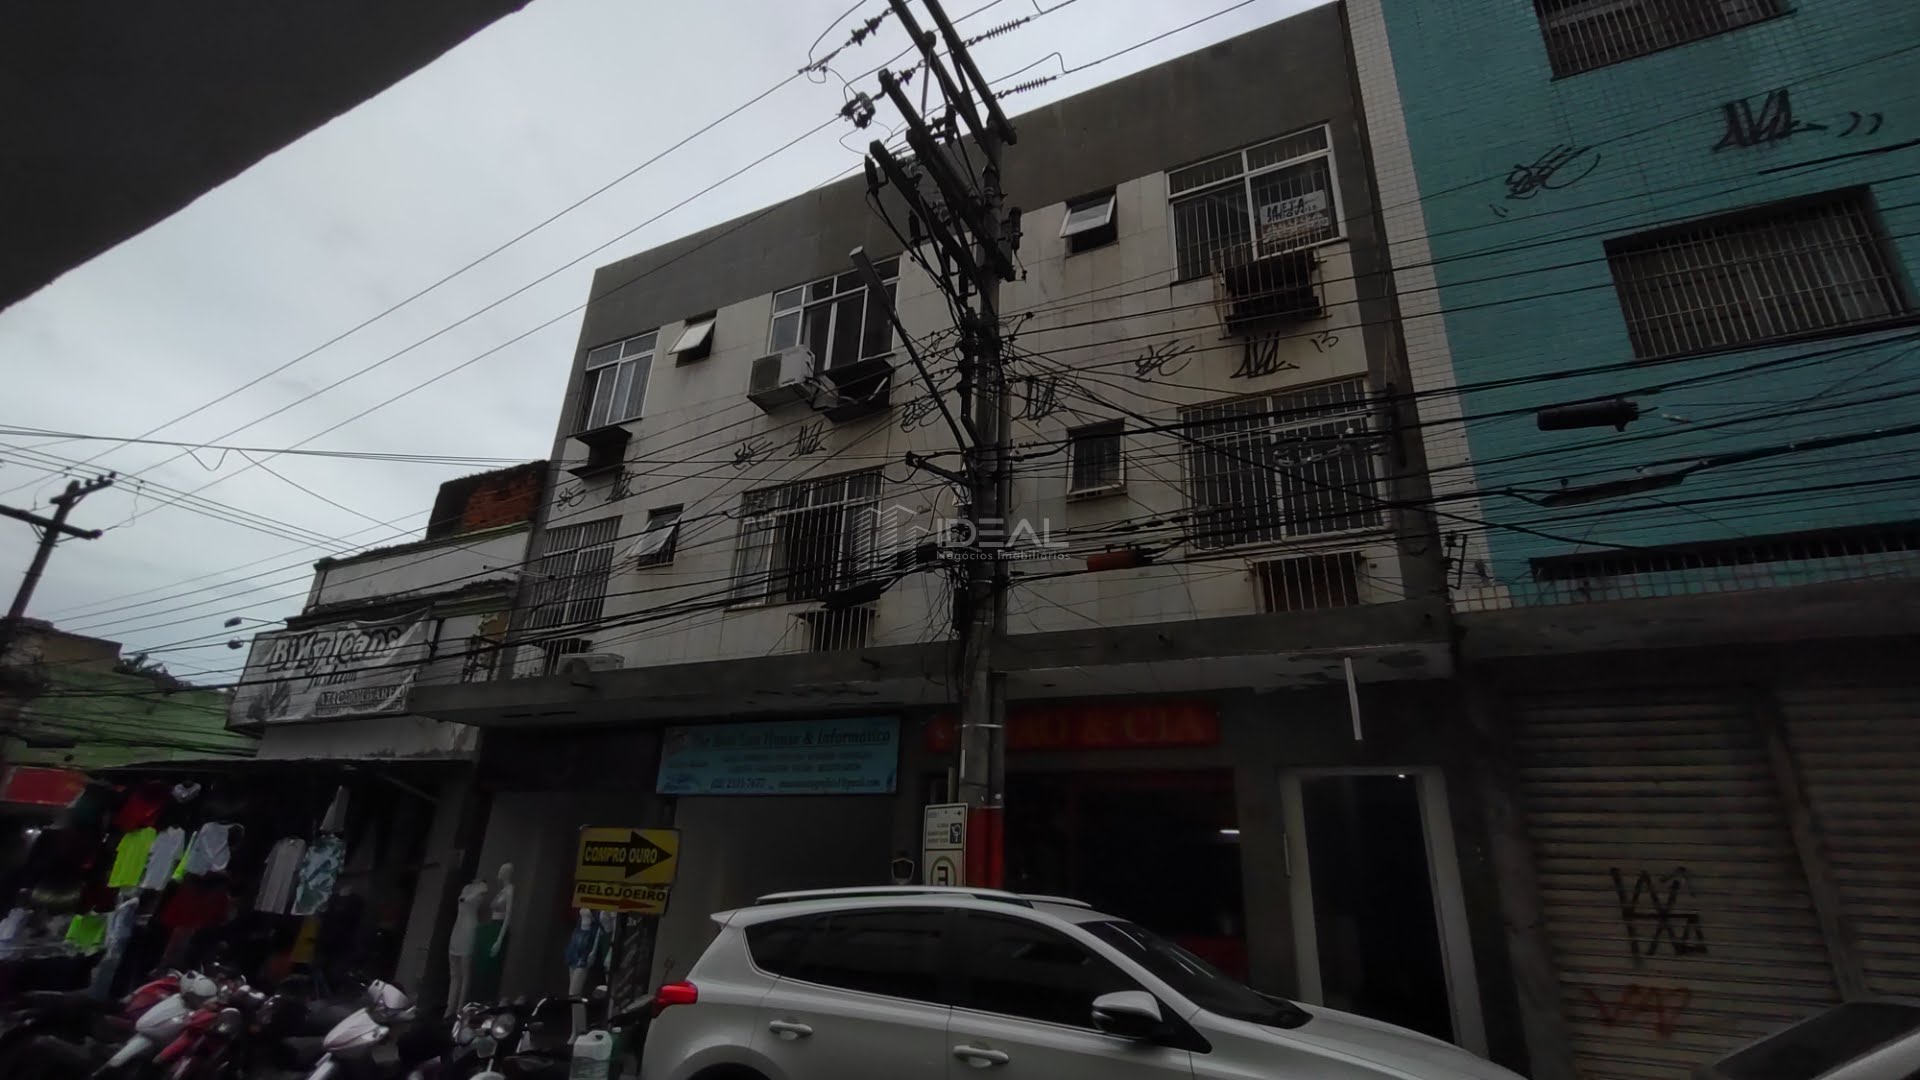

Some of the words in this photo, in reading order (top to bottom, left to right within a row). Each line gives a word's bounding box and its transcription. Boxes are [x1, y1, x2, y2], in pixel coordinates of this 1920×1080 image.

[1121, 707, 1206, 743] CIA
[584, 846, 627, 862] COMPRO
[628, 847, 658, 864] OURO
[576, 884, 666, 902] RELOJOEIRO
